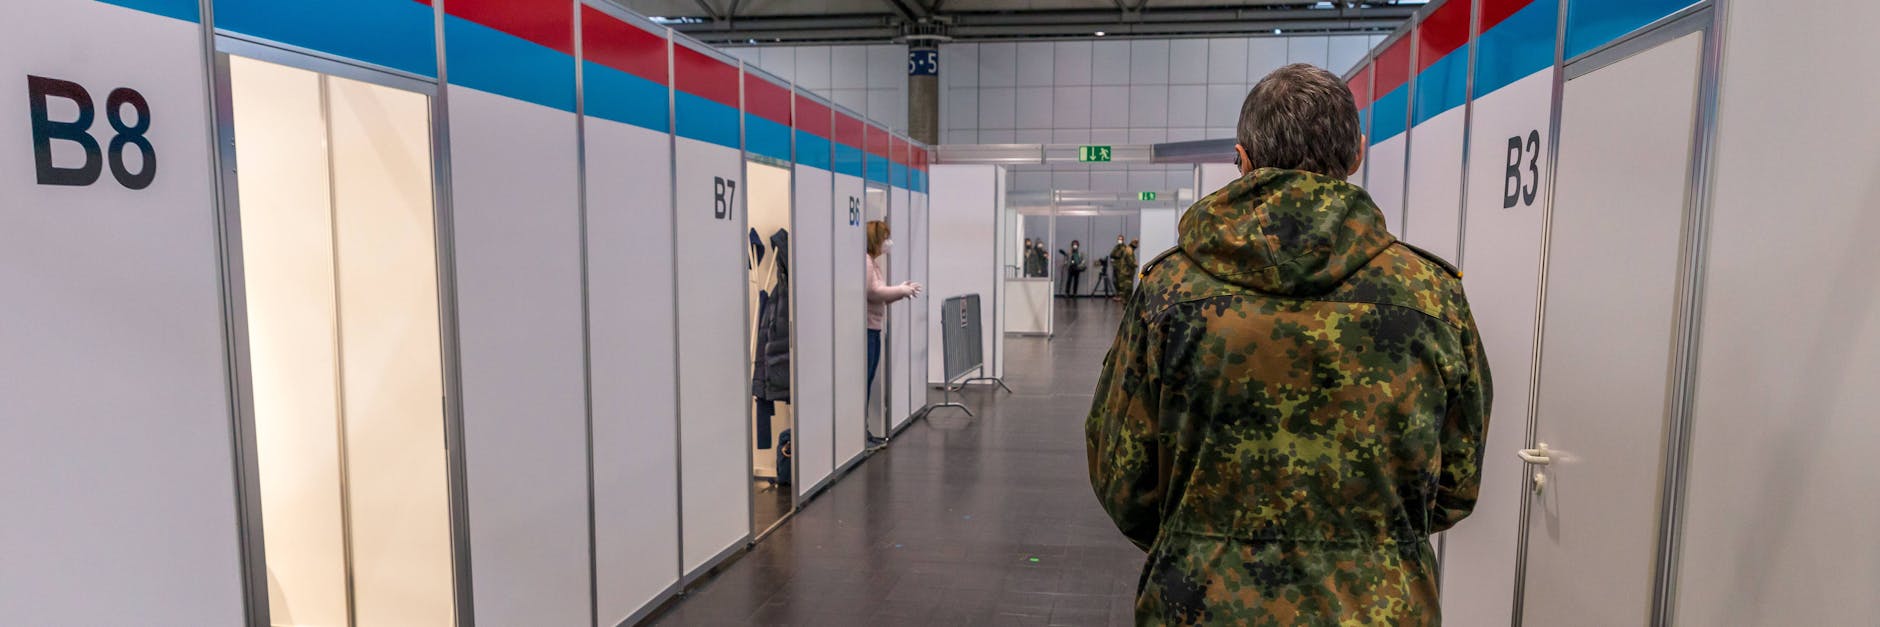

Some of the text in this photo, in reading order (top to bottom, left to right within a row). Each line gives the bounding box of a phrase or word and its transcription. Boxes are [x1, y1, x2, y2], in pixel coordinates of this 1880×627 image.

[27, 74, 157, 190] B8
[714, 175, 736, 221] B7
[1503, 129, 1541, 209] B3
[849, 195, 861, 227] B6
